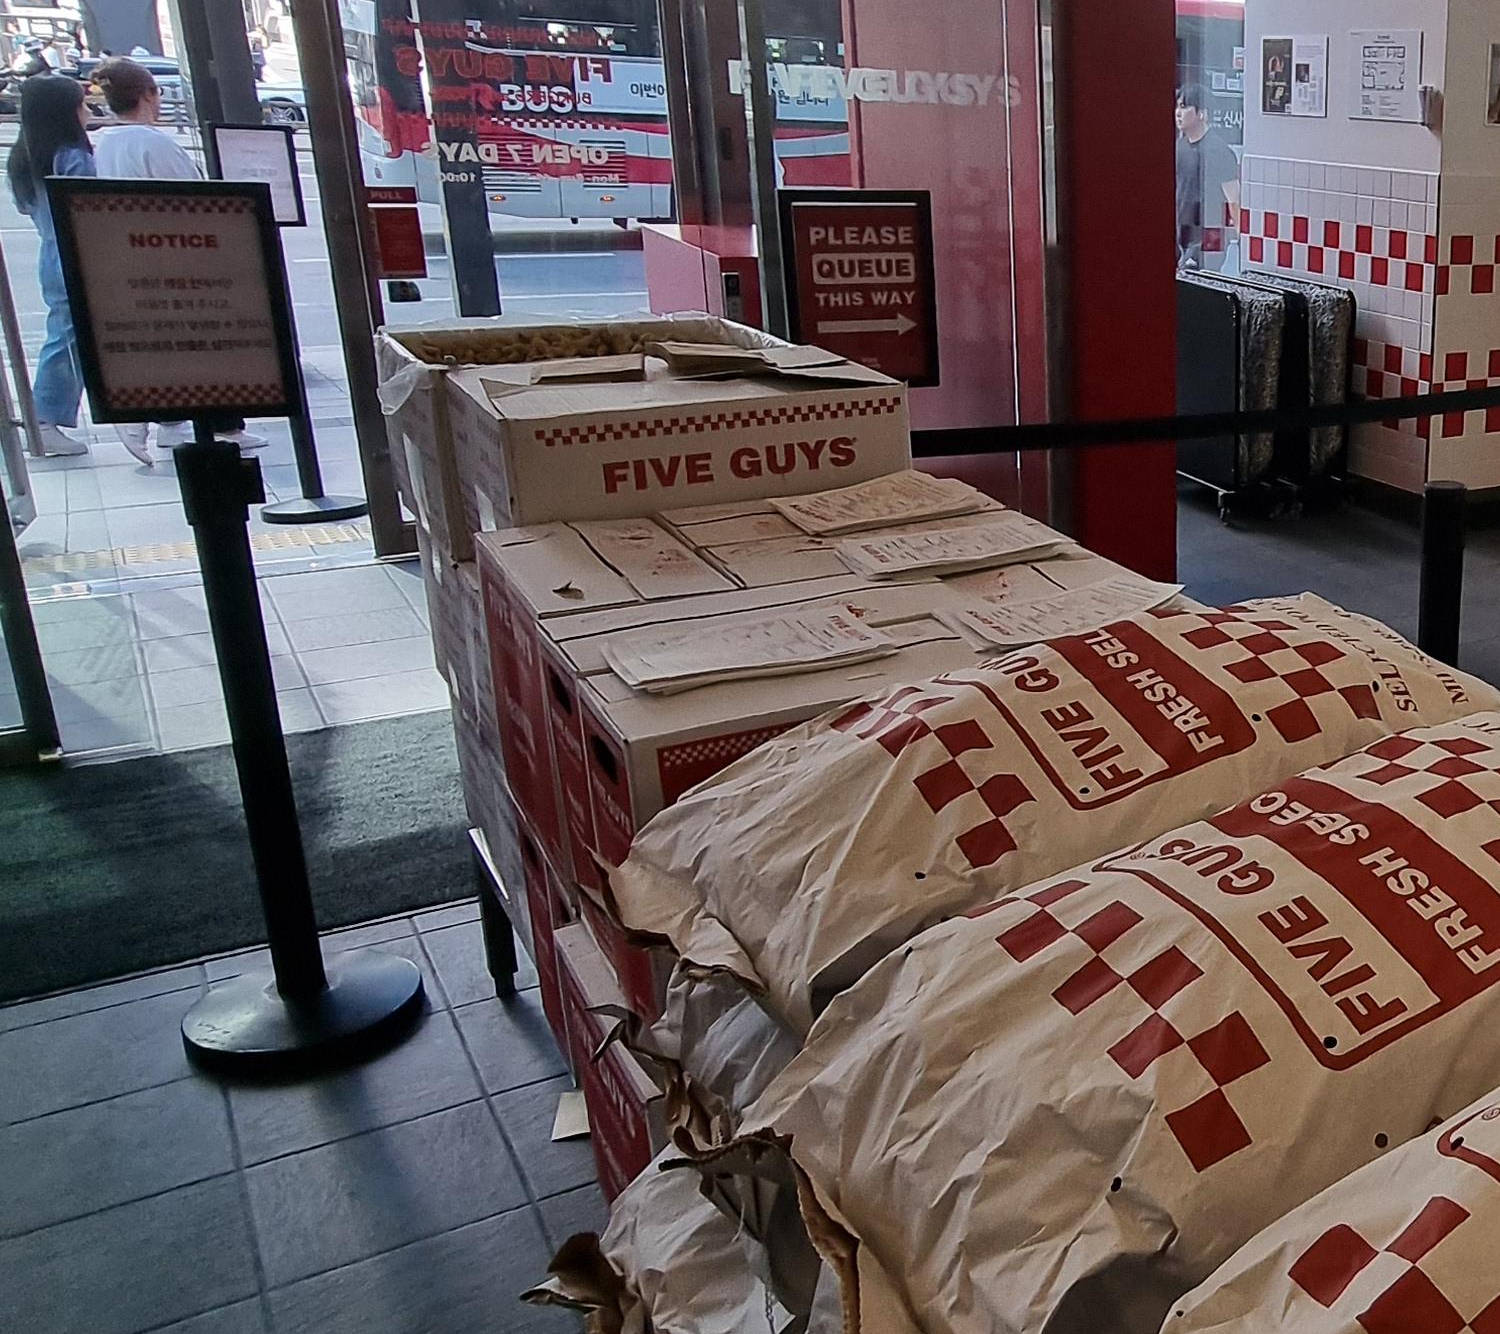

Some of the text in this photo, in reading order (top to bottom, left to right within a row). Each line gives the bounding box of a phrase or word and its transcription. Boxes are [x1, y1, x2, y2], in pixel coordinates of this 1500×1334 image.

[129, 233, 220, 250] NOTICE
[808, 226, 914, 246] PLEASE
[816, 258, 911, 279] QUEUE
[815, 291, 916, 307] THIS WAY
[603, 436, 857, 494] FIVE GUYS
[1085, 628, 1225, 754] FRESH SEL
[1040, 700, 1145, 793] FIVE
[1257, 895, 1409, 1036] FIVE
